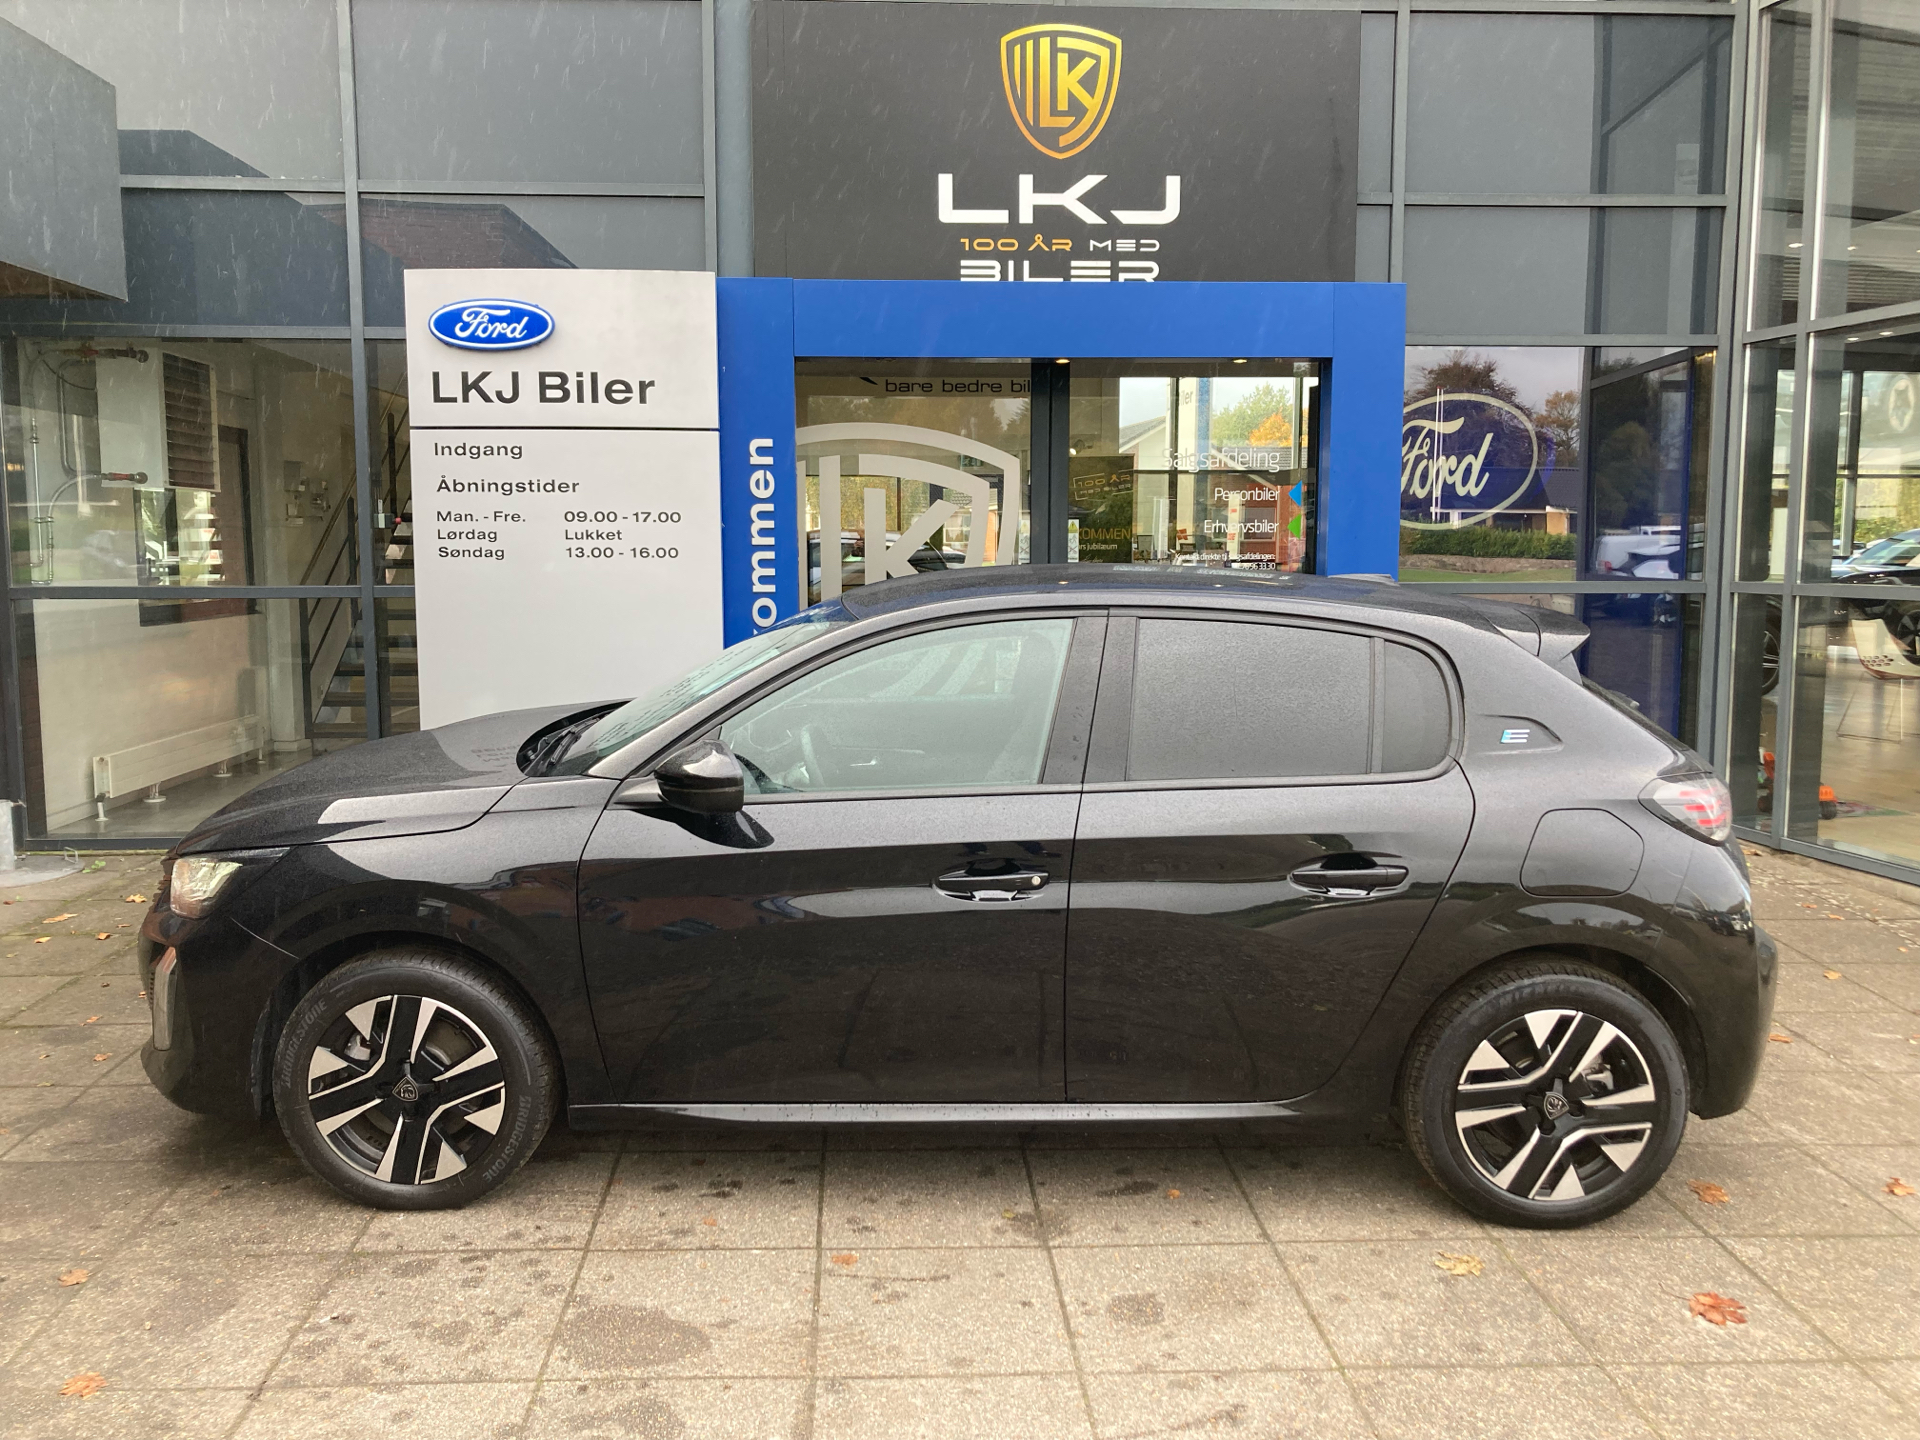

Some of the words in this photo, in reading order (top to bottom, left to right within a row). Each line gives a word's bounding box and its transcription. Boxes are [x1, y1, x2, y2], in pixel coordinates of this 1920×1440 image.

[938, 173, 1181, 225] LKJ
[960, 238, 1019, 251] 100
[1028, 234, 1073, 252] ÅR
[1090, 239, 1160, 252] MED
[960, 260, 1160, 282] BILER
[432, 371, 520, 404] LKJ
[538, 371, 656, 404] Biler
[885, 379, 933, 393] bare
[942, 379, 1002, 393] bedre
[434, 442, 523, 459] Indgang
[1162, 447, 1281, 473] Salgsafdeling
[437, 474, 580, 495] Åbningstider
[1078, 478, 1106, 488] 100
[1214, 487, 1280, 501] Personbiler
[437, 511, 479, 522] Man.
[494, 511, 526, 522] Fre.
[564, 511, 618, 523] 09.00
[632, 511, 682, 523] 17.00
[1204, 519, 1279, 533] Erhvervsbiler
[437, 529, 498, 542] Lørdag
[565, 529, 623, 540] Lukket
[750, 438, 777, 634] ommen
[438, 546, 505, 560] Søndag
[566, 547, 614, 559] 13.00
[630, 547, 679, 559] 16.00
[483, 1094, 532, 1183] BRIDGESTONE
